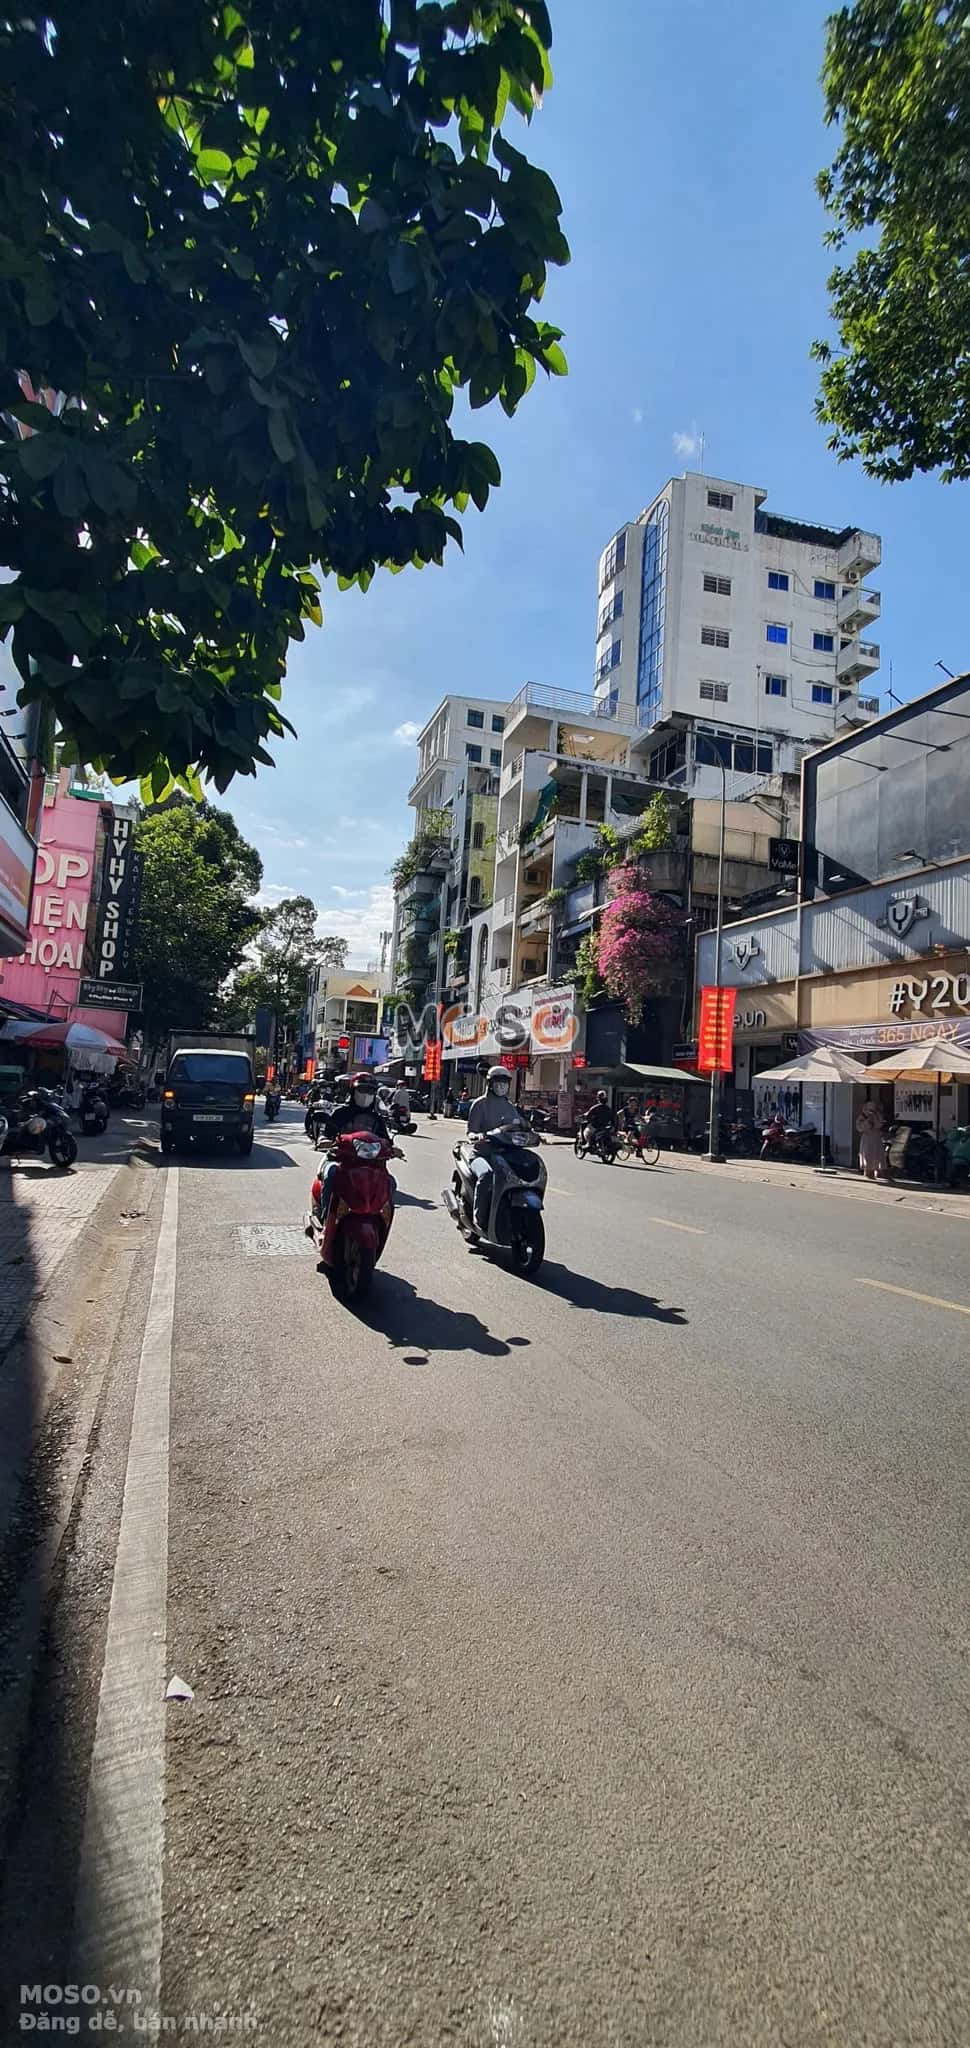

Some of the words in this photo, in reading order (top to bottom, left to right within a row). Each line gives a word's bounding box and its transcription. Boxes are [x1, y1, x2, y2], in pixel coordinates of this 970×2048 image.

[113, 819, 129, 896] HYHY
[7, 938, 84, 973] HỌAI
[99, 901, 120, 978] SHOP
[878, 1028, 905, 1044] 365
